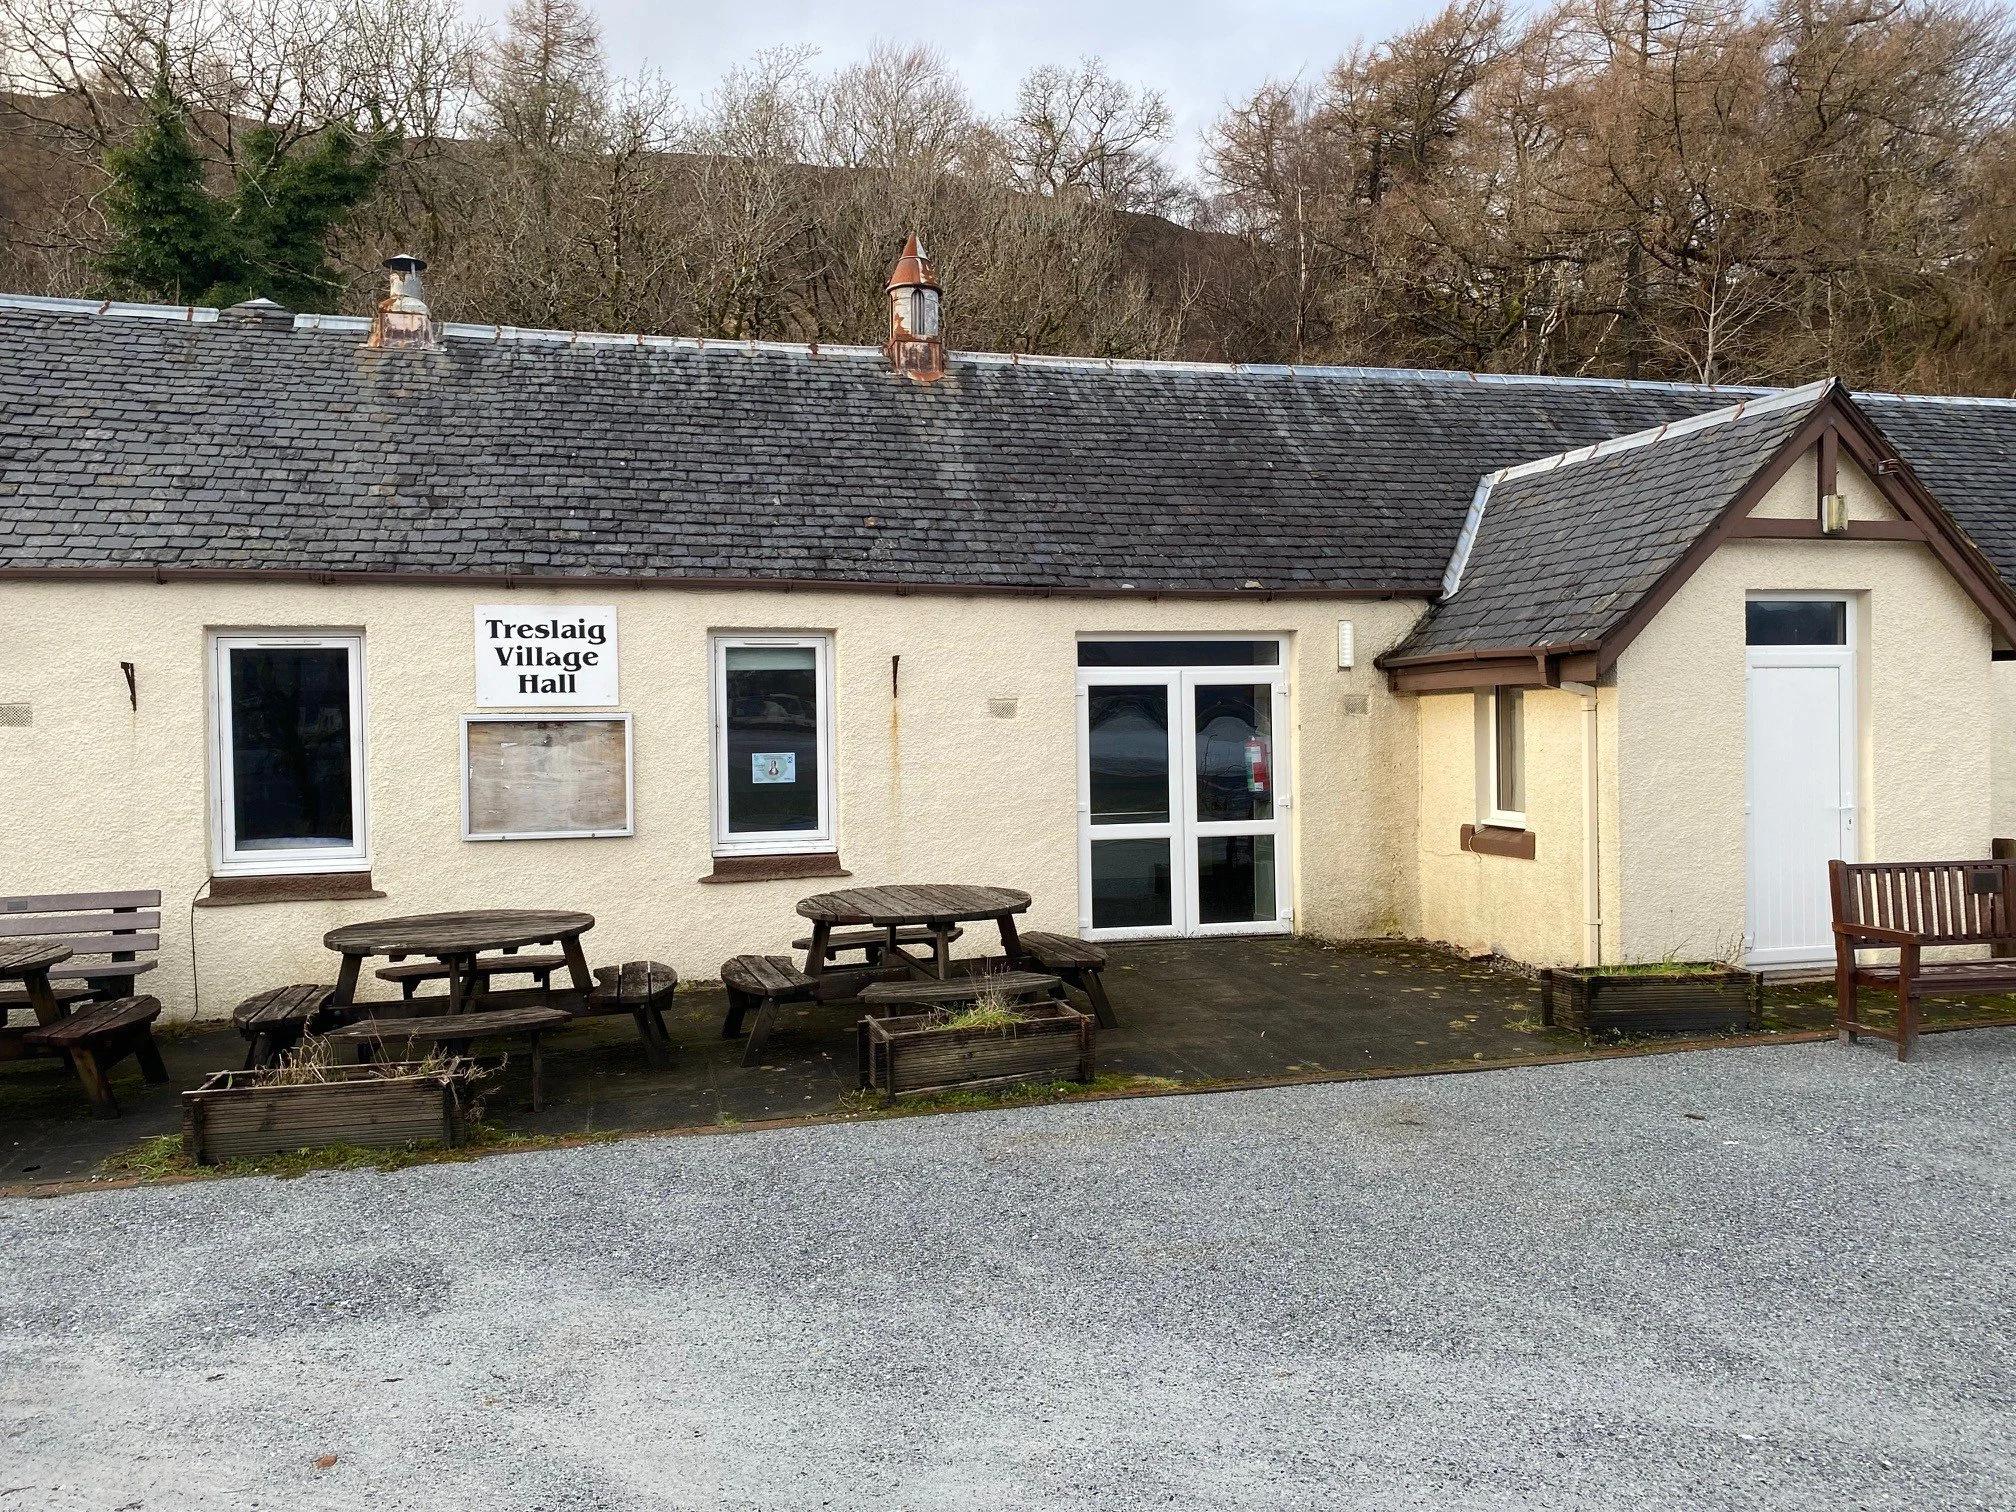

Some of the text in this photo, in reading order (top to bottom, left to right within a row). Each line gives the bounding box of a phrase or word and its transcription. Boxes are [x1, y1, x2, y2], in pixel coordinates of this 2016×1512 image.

[485, 618, 607, 645] Treslaig
[494, 645, 599, 671] Village
[518, 674, 577, 694] Hall
